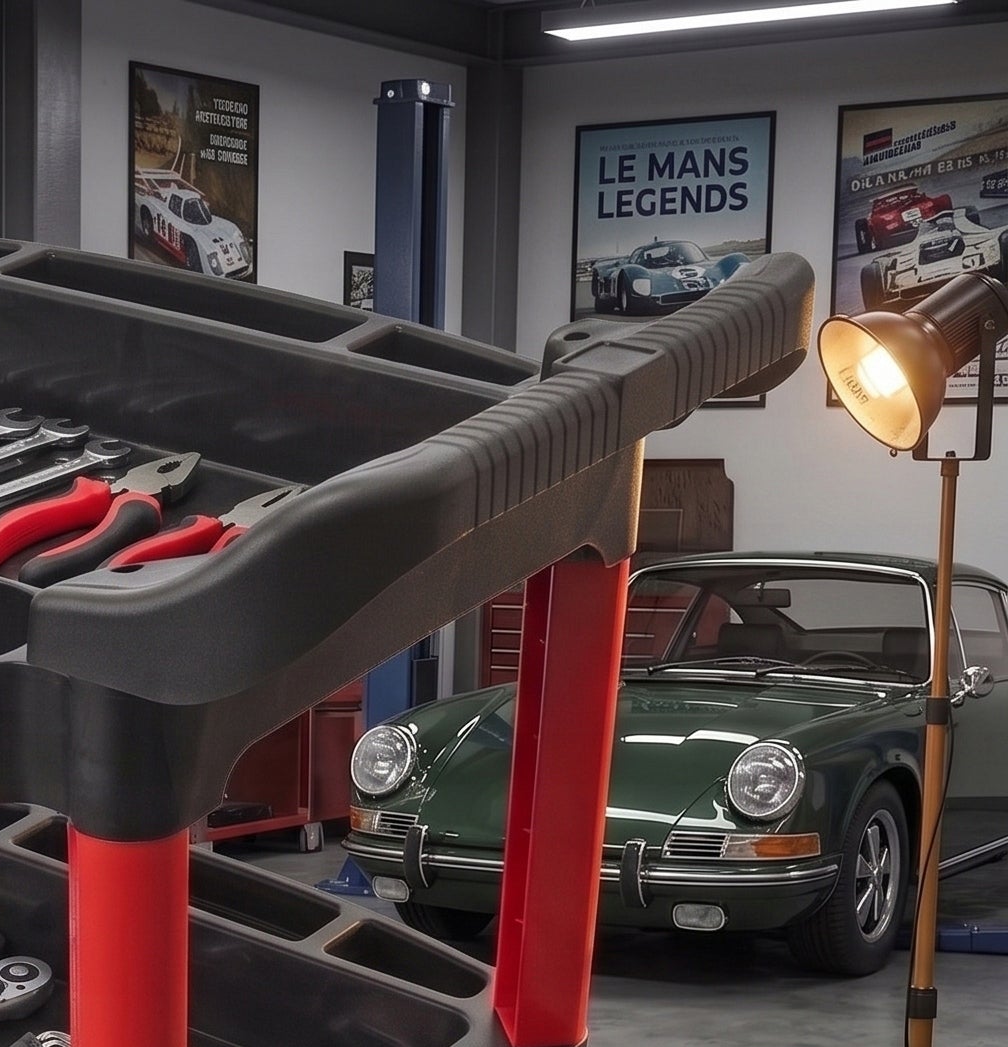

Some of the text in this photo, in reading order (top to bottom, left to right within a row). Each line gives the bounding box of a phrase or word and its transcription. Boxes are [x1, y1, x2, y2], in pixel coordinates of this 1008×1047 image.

[598, 145, 750, 185] LE MANS
[597, 181, 749, 219] LEGENDS
